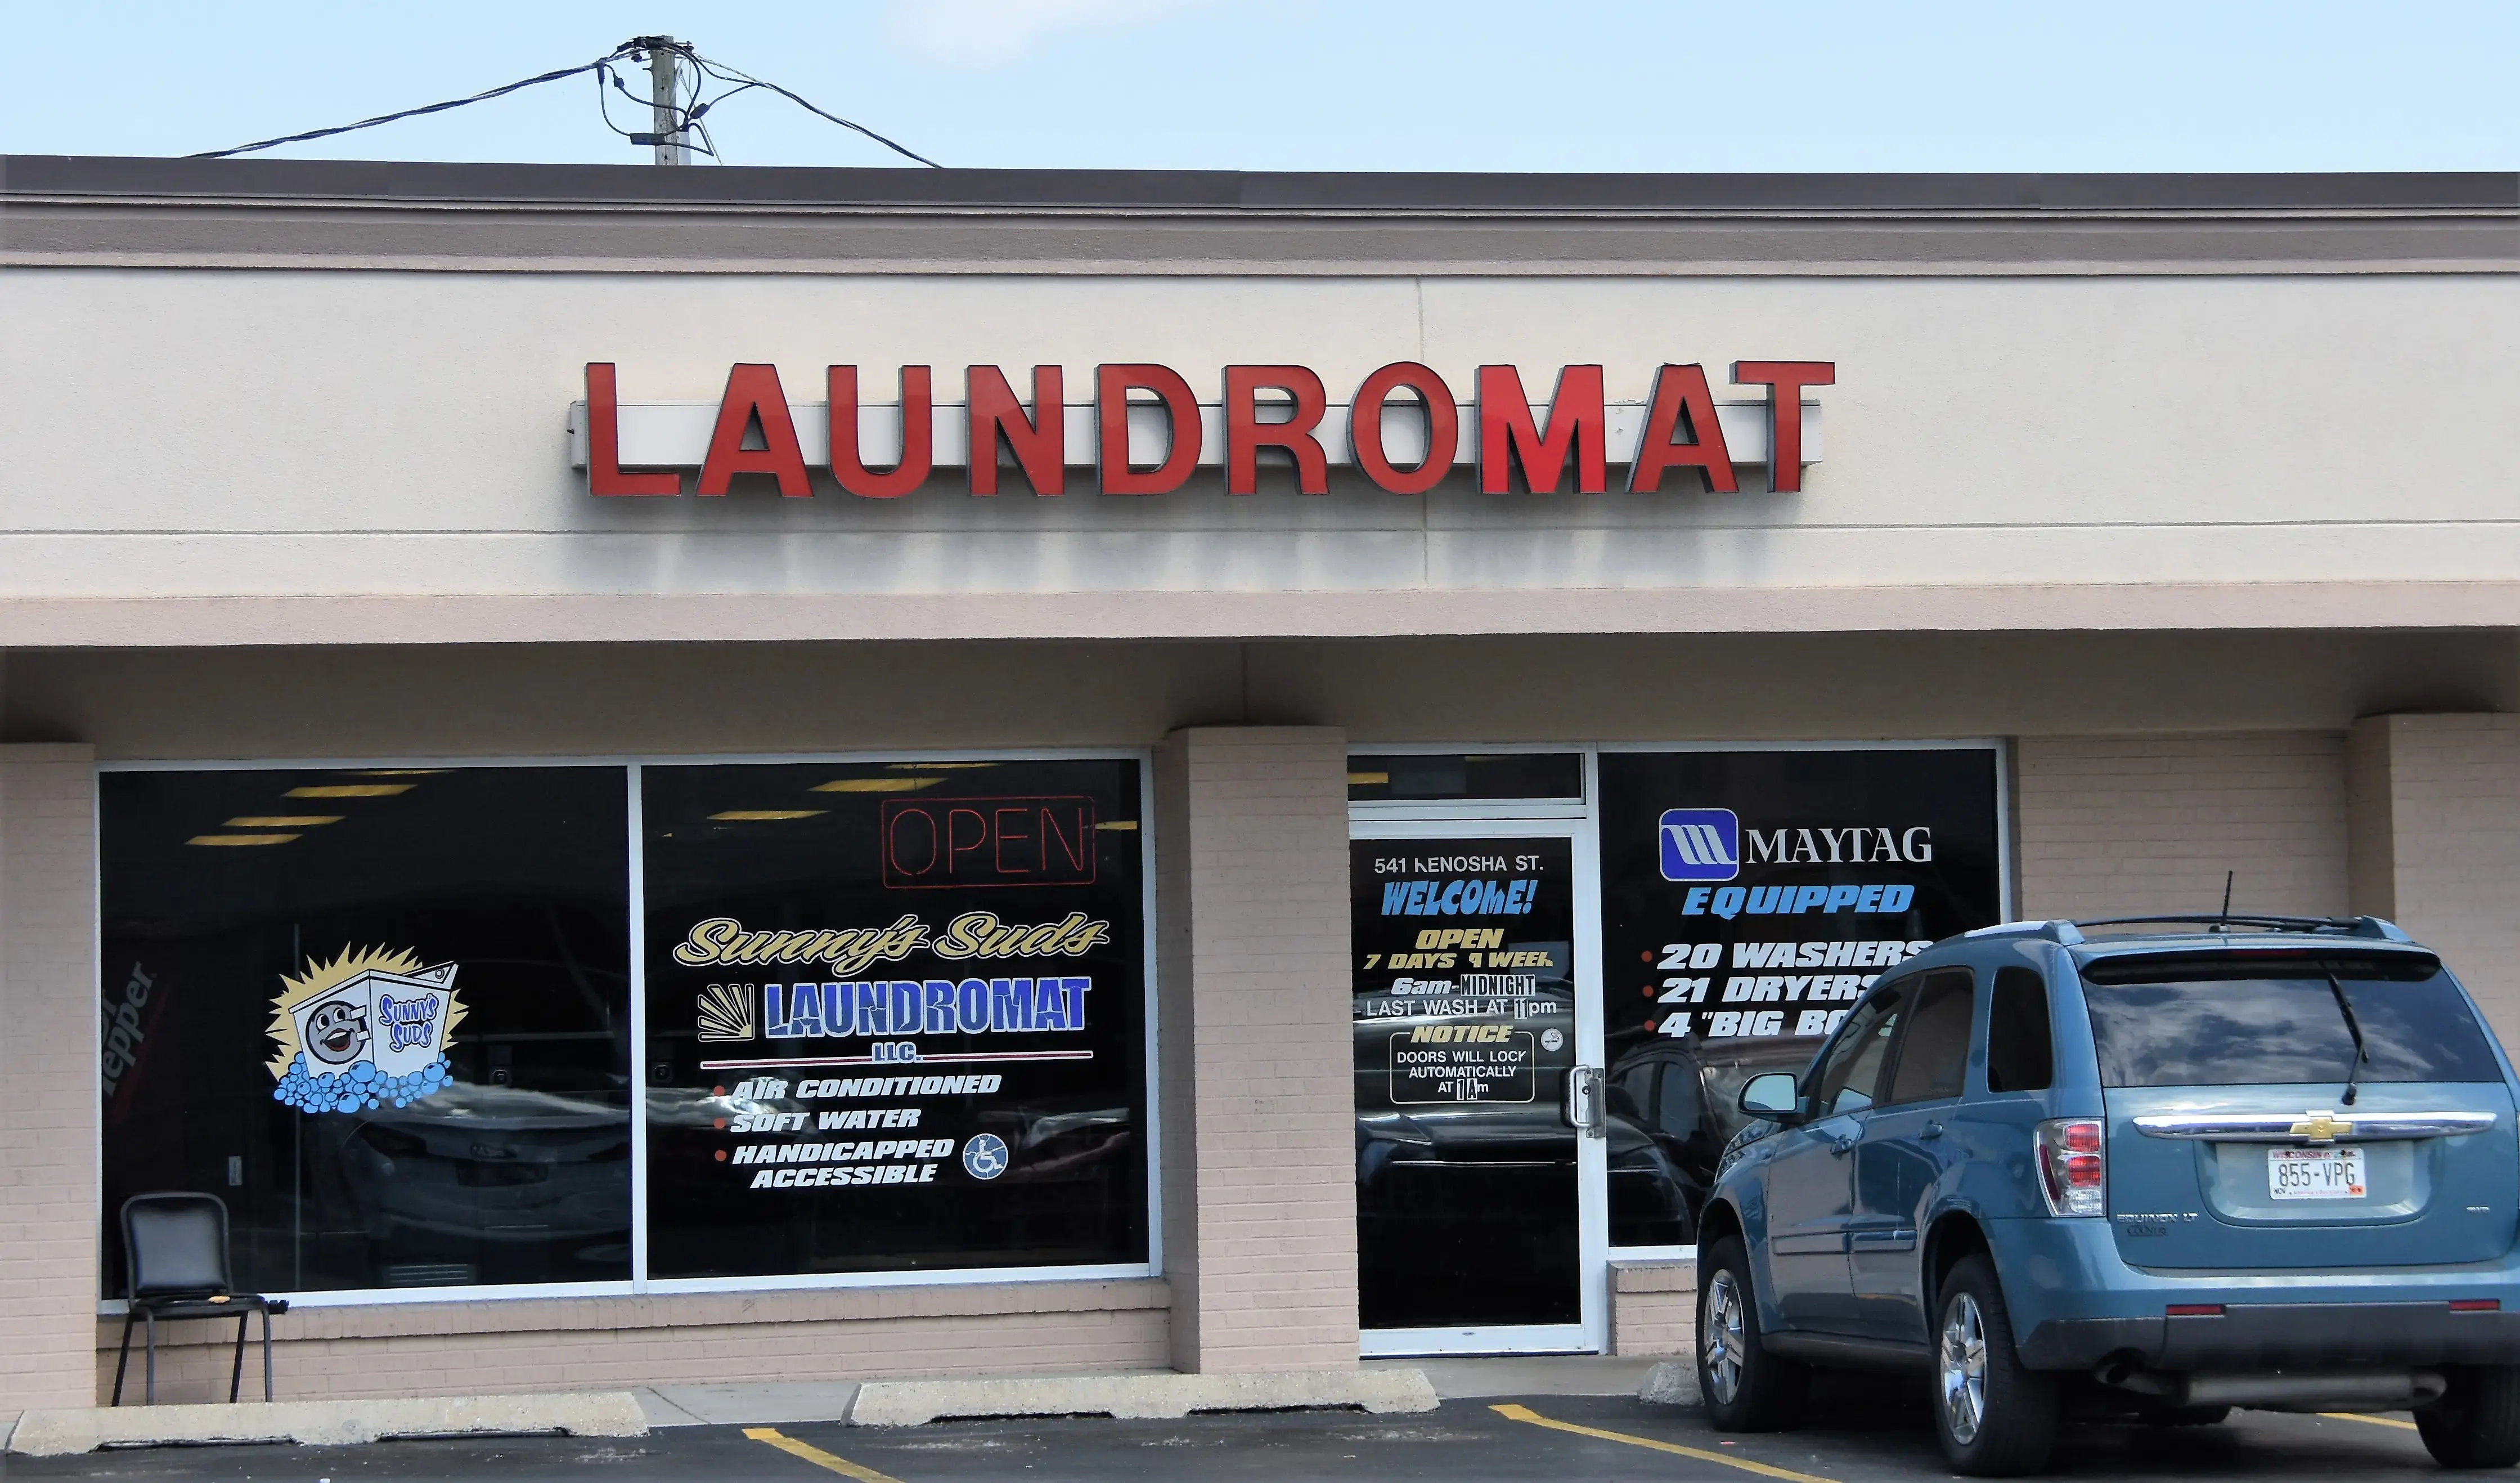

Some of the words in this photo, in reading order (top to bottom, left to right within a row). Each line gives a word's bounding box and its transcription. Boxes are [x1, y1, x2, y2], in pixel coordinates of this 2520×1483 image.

[585, 360, 1835, 498] LAUNDROMAT
[891, 807, 1084, 875] OPEN
[1745, 827, 1932, 863] MAYTAG
[1374, 858, 1406, 873] 541
[1414, 855, 1507, 873] KENOSHA
[1515, 855, 1544, 871] ST.
[1381, 879, 1538, 915] WELCOME!
[1681, 884, 1915, 920] EQUIPPED
[673, 915, 930, 977] Sunny's
[932, 911, 1109, 960] Suds
[1415, 928, 1504, 949] OPEN
[1363, 954, 1381, 969] 7
[1388, 953, 1457, 969] DAYS
[1657, 943, 1723, 969] 20
[1657, 977, 1710, 1003] 21
[764, 976, 1091, 1039] LAUNDROMAT
[1367, 1000, 1416, 1016] LAST
[1423, 1000, 1477, 1015] WASH
[1486, 999, 1508, 1014] AT
[1514, 998, 1557, 1020] 11pm
[390, 1021, 433, 1052] SUDS
[1411, 1025, 1513, 1043] NOTICE
[1658, 1012, 1691, 1038] 4
[1702, 1010, 1784, 1037] "BIG
[872, 1042, 923, 1063] LLC.
[1397, 1051, 1447, 1063] DOORS
[1452, 1051, 1484, 1063] WILL
[1409, 1065, 1516, 1078] AUTOMATICALLY
[731, 1077, 787, 1100] AIR
[796, 1074, 1002, 1099] CONDITIONED
[1438, 1081, 1454, 1093] AT
[730, 1112, 810, 1133] SOFT
[819, 1109, 922, 1130] WATER
[732, 1139, 955, 1164] HANDICAPPED
[2272, 1150, 2322, 1159] WISCONSIN
[750, 1164, 938, 1189] ACCESSIBLE
[2279, 1162, 2355, 1187] 855-VPG
[2116, 1213, 2178, 1222] EQUINOX
[2182, 1213, 2198, 1222] LT
